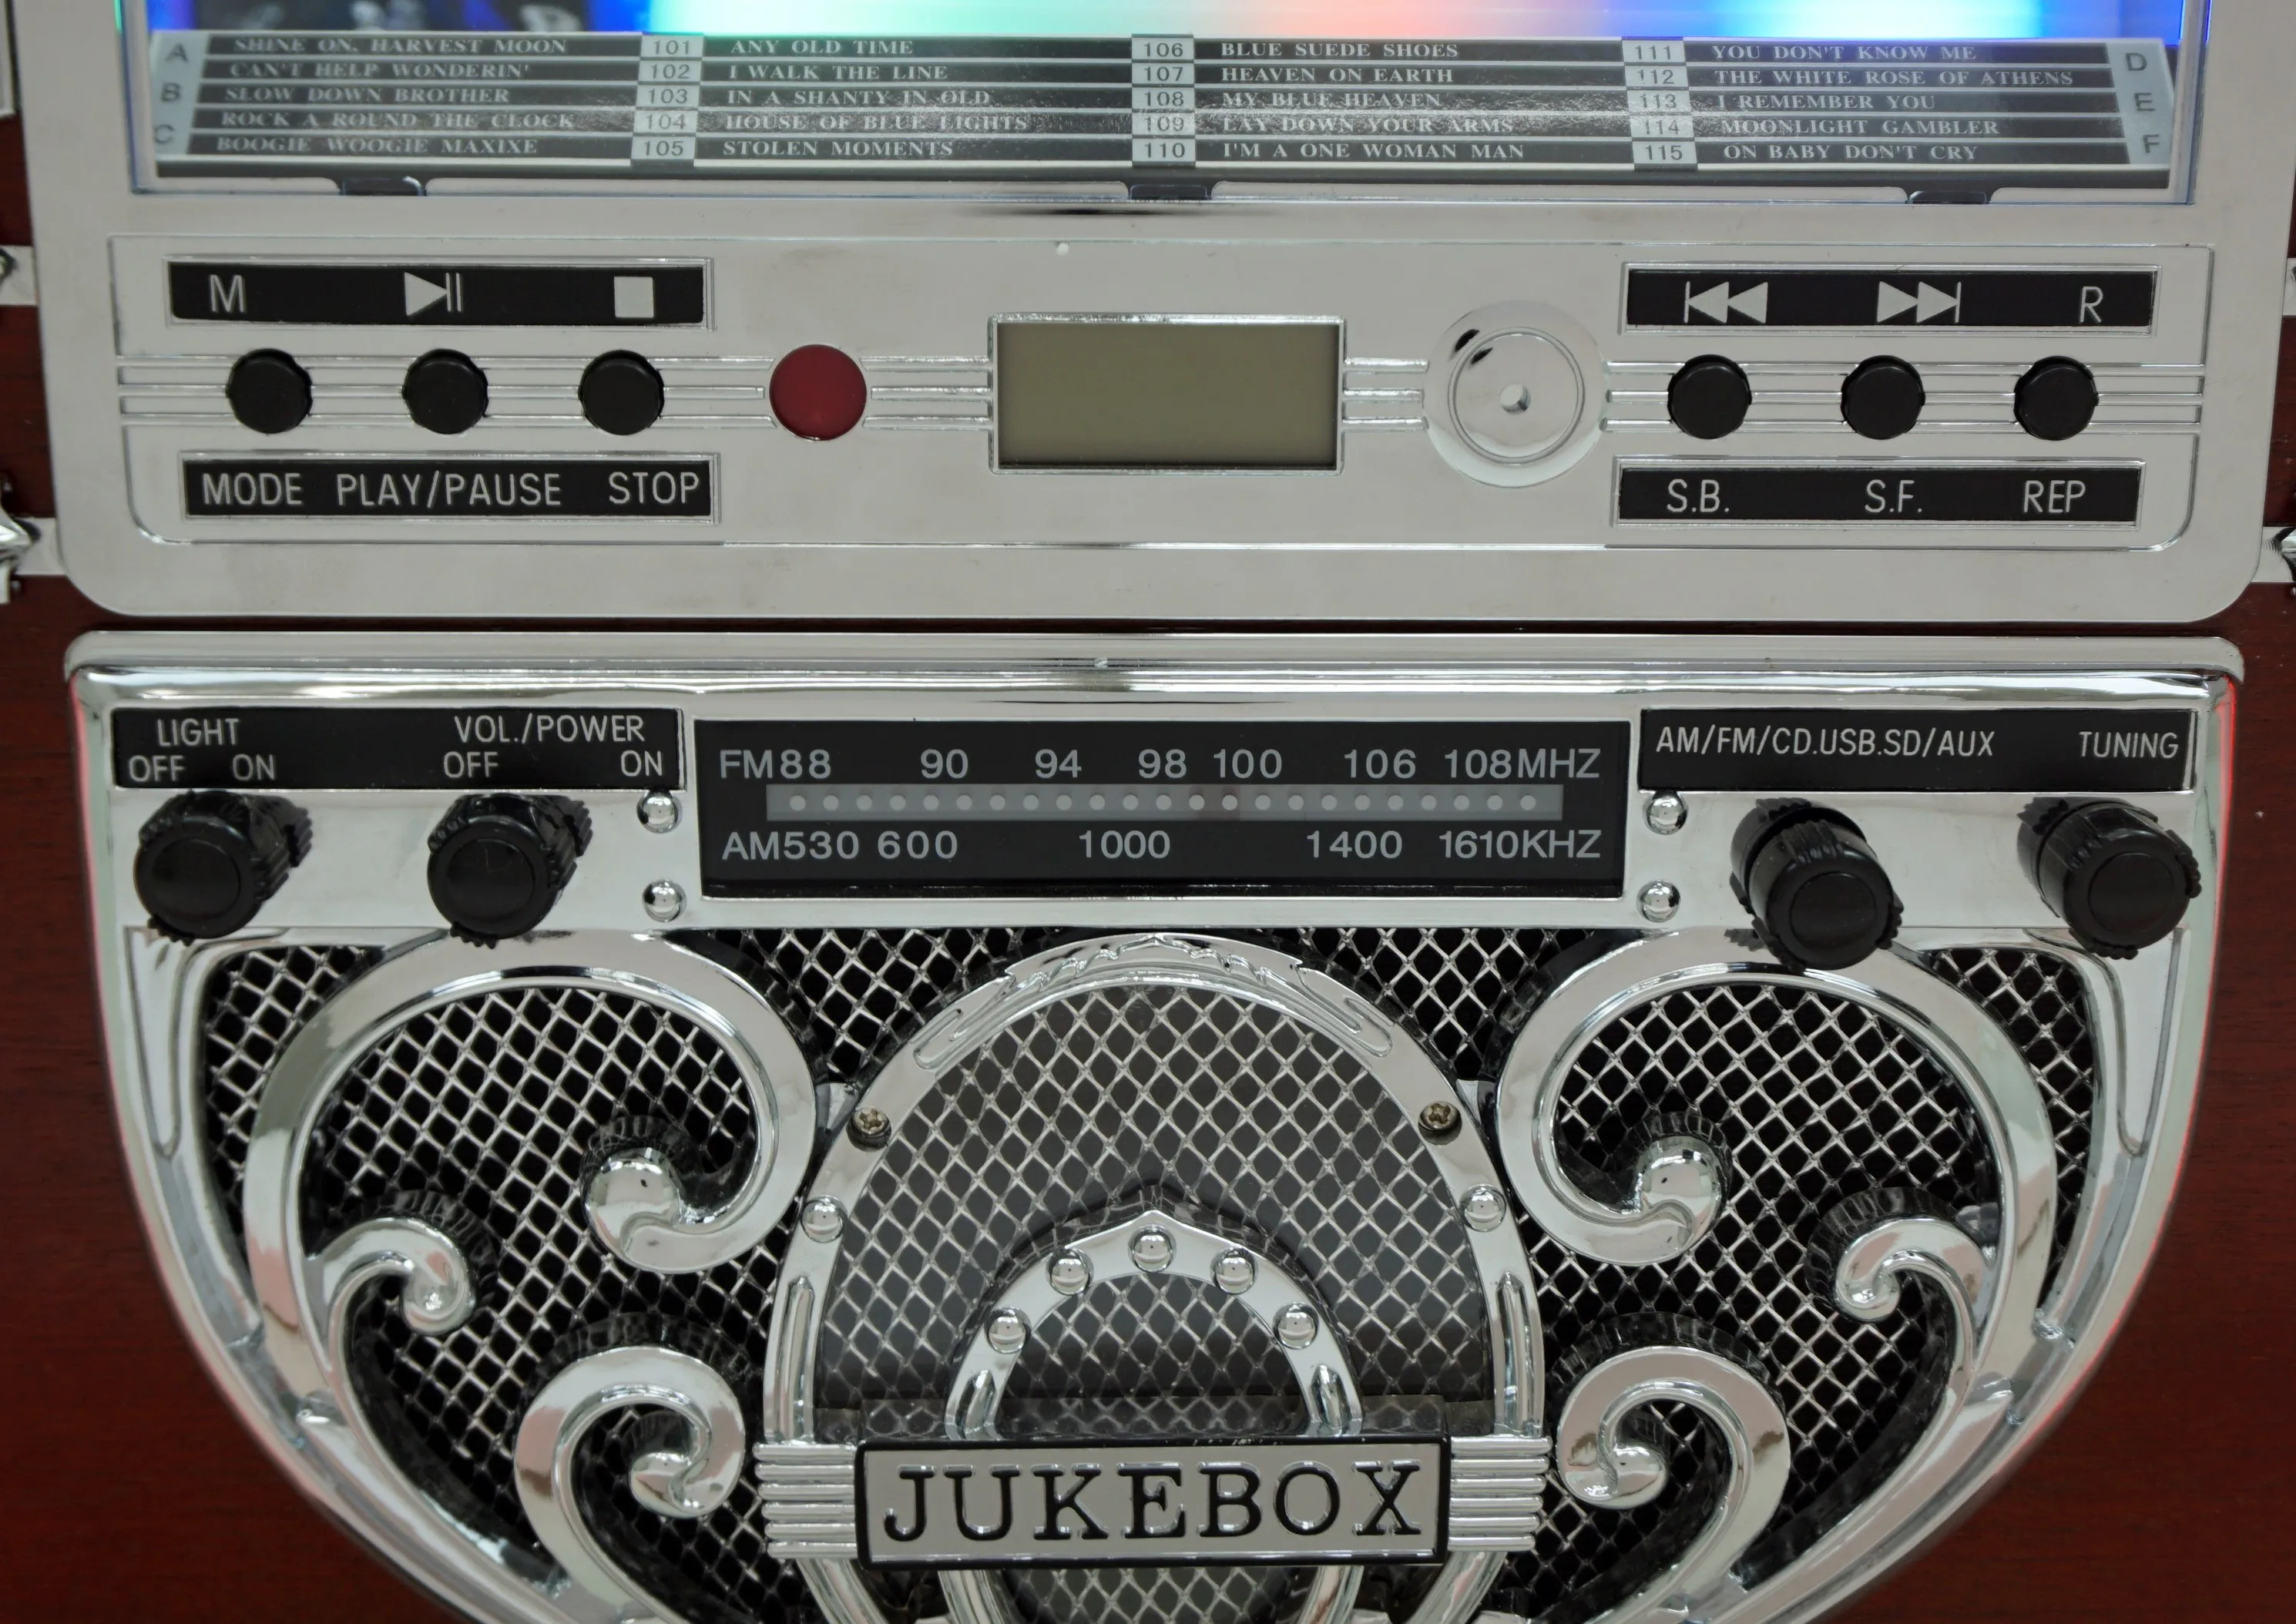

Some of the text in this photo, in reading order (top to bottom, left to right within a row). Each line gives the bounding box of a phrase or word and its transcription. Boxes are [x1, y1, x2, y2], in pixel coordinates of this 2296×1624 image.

[165, 44, 188, 62] A
[234, 39, 305, 52] SHINE
[371, 39, 482, 52] HARVEST
[494, 40, 568, 52] MOON
[653, 41, 690, 54] 101
[731, 40, 912, 54] ANY OLD TIME
[1144, 43, 1183, 57] 106
[1221, 43, 1458, 57] BLUE SUEDE SHOES
[1635, 46, 1671, 59] 111
[1712, 46, 1975, 59] YOU DON'T KNOW ME
[2125, 53, 2147, 71] D
[230, 63, 531, 77] CAN'T HELP WONDERIN'
[651, 64, 690, 79] 102
[729, 65, 947, 79] I WALK THE LINE
[1144, 67, 1183, 81] 107
[1221, 68, 1453, 82] HEAVEN ON EARTH
[1637, 70, 1674, 84] 112
[1714, 71, 2073, 85] THE WHITE ROSE OF ATHENS
[160, 83, 181, 102] B
[225, 88, 510, 102] SLOW DOWN BROTHER
[649, 89, 687, 103] 103
[728, 91, 989, 104] IN A SHANTY IN OLD
[1145, 92, 1183, 106] 108
[1223, 92, 1440, 106] MY BLUE HEAVEN
[1640, 95, 1676, 108] 113
[1719, 96, 1935, 109] I REMEMBER YOU
[2133, 92, 2155, 112] E
[222, 113, 576, 128] ROCK A ROUND THE CLOCK
[646, 114, 686, 129] 104
[726, 116, 1027, 129] HOUSE OF BLUE LIGHTS
[1145, 117, 1183, 131] 109
[1223, 118, 1512, 132] LAY DOWN YOUR ARMS
[1643, 119, 1680, 134] 114
[1723, 120, 2000, 134] MOONLIGHT GAMBLER
[153, 125, 174, 144] C
[217, 137, 538, 153] BOOGIE WOOGIE MAXIXE
[644, 141, 684, 156] 105
[723, 141, 952, 156] STOLEN MOMENTS
[1145, 143, 1185, 157] 110
[1223, 143, 1523, 158] I'M A ONE WOMAN MAN
[2142, 135, 2160, 153] F
[1646, 146, 1683, 159] 115
[1724, 146, 1978, 159] ON BABY DON'T CRY
[210, 275, 245, 313] M
[2080, 287, 2102, 323] R
[203, 473, 303, 505] MODE
[337, 471, 561, 508] PLAY/PAUSE
[609, 471, 700, 504] STOP
[1667, 480, 1729, 512] S.B.
[1865, 480, 1922, 512] S.F.
[2023, 480, 2086, 512] REP
[157, 718, 240, 746] LIGHT
[454, 714, 644, 744] VOL./POWER
[2079, 731, 2179, 759] TUNING
[129, 754, 277, 782] OFF ON
[444, 750, 663, 778] OFF ON
[921, 749, 968, 779] 90
[1035, 749, 1082, 779] 94
[1138, 749, 1187, 779] 98
[1213, 749, 1282, 779] 100
[1344, 749, 1416, 779] 106
[878, 830, 958, 859] 600
[1079, 830, 1170, 858] 1000
[1307, 830, 1402, 858] 1400
[884, 1460, 1422, 1542] JUKEBOX
